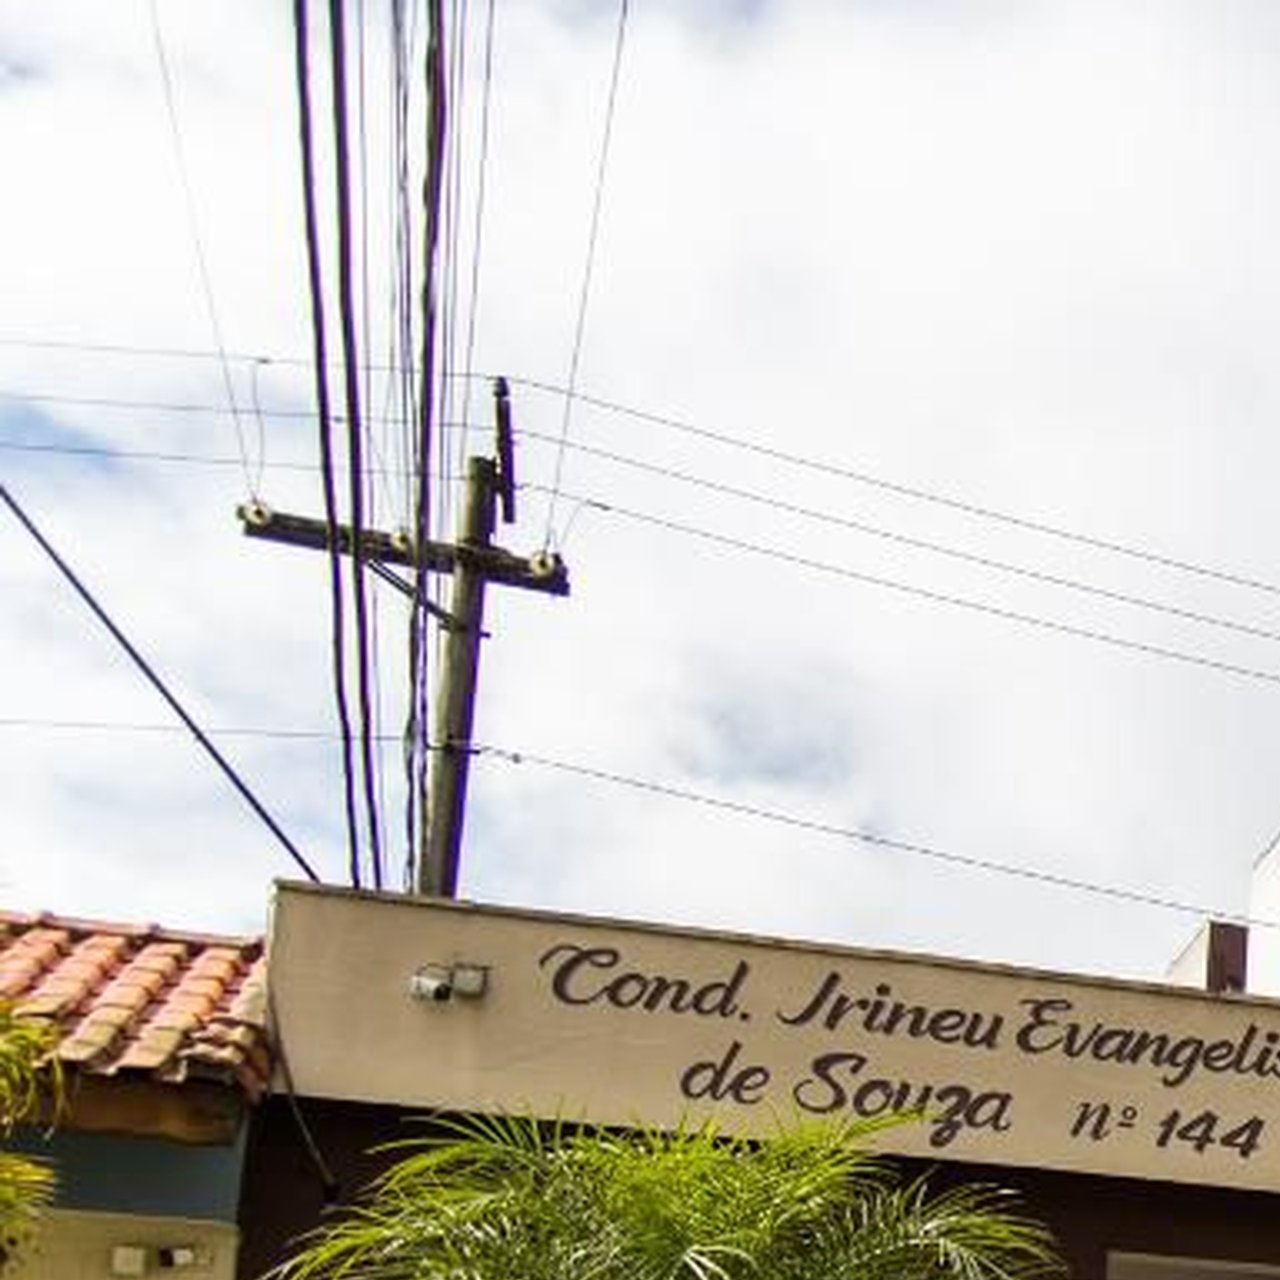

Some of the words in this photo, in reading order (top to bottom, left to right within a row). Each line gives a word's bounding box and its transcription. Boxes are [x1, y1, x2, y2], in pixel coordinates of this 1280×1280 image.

[539, 943, 750, 1021] Cond.
[679, 1041, 771, 1105] de
[793, 1052, 1012, 1148] Souza
[1155, 1109, 1266, 1159] 144
